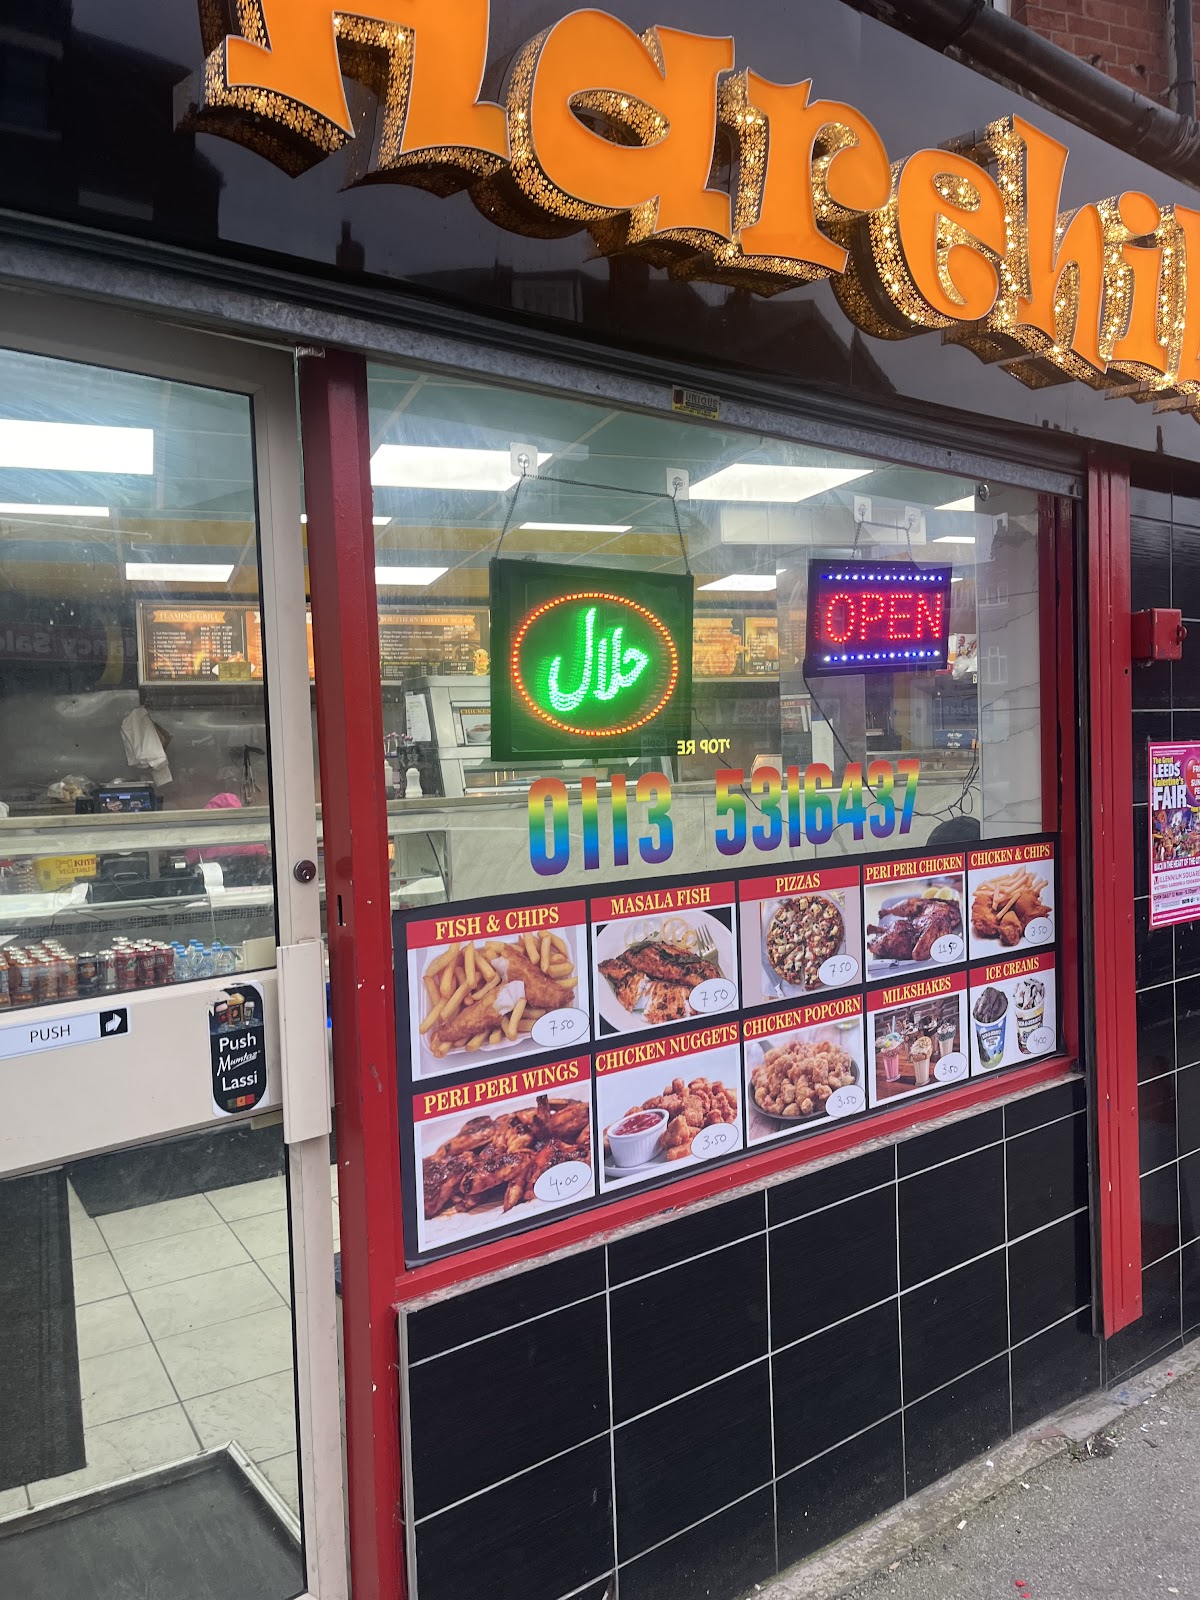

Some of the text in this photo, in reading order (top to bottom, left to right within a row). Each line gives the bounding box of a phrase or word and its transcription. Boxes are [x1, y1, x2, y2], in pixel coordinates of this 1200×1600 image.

[825, 591, 942, 644] OPEN
[547, 606, 650, 712] حلال
[1153, 761, 1181, 778] LEEDS
[1153, 776, 1184, 787] Valentine's
[1153, 784, 1187, 811] FAIR
[528, 758, 920, 877] 0113 5316437
[866, 855, 963, 881] PERI PERI CHICKEN
[970, 844, 1050, 867] CHICKEN & CHIPS
[775, 873, 821, 893] PIZZAS
[610, 887, 711, 916] MASALA FISH
[435, 906, 560, 941] FISH & CHIPS
[985, 956, 1040, 982] ICE CREAMS
[882, 976, 952, 1005] MILKSHAKES
[743, 996, 861, 1038] CHICKEN POPCORN
[30, 1024, 71, 1043] PUSH
[219, 1032, 257, 1054] Push
[595, 1025, 738, 1073] CHICKEN NUGGETS
[217, 1052, 258, 1077] Mumtaz
[222, 1071, 258, 1092] Lassi
[424, 1060, 580, 1116] PERI PERI WINGS
